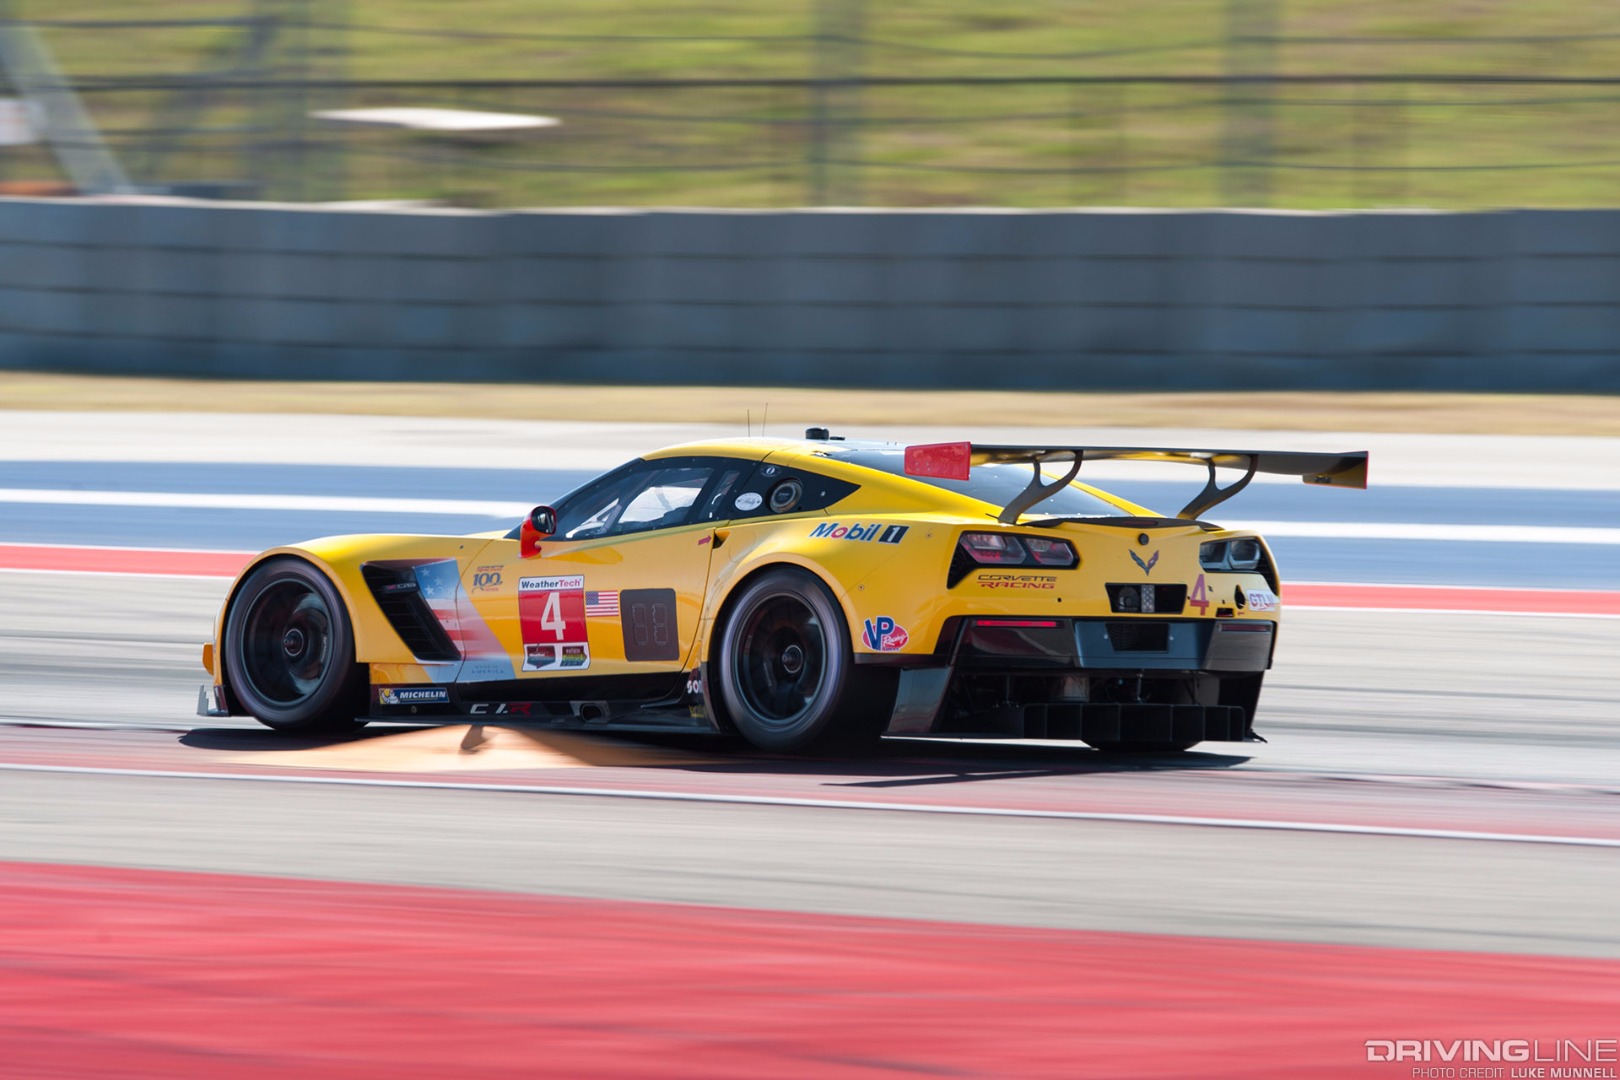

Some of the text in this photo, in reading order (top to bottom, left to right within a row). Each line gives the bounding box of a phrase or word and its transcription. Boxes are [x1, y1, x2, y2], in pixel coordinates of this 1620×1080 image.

[810, 523, 882, 541] Mobil
[521, 579, 580, 589] WeatherTech
[977, 581, 1055, 589] RACING
[978, 574, 1057, 582] CORVETTE
[1190, 574, 1209, 616] 4
[541, 592, 566, 640] 4
[864, 616, 895, 651] VP
[400, 690, 446, 699] MICHELIN
